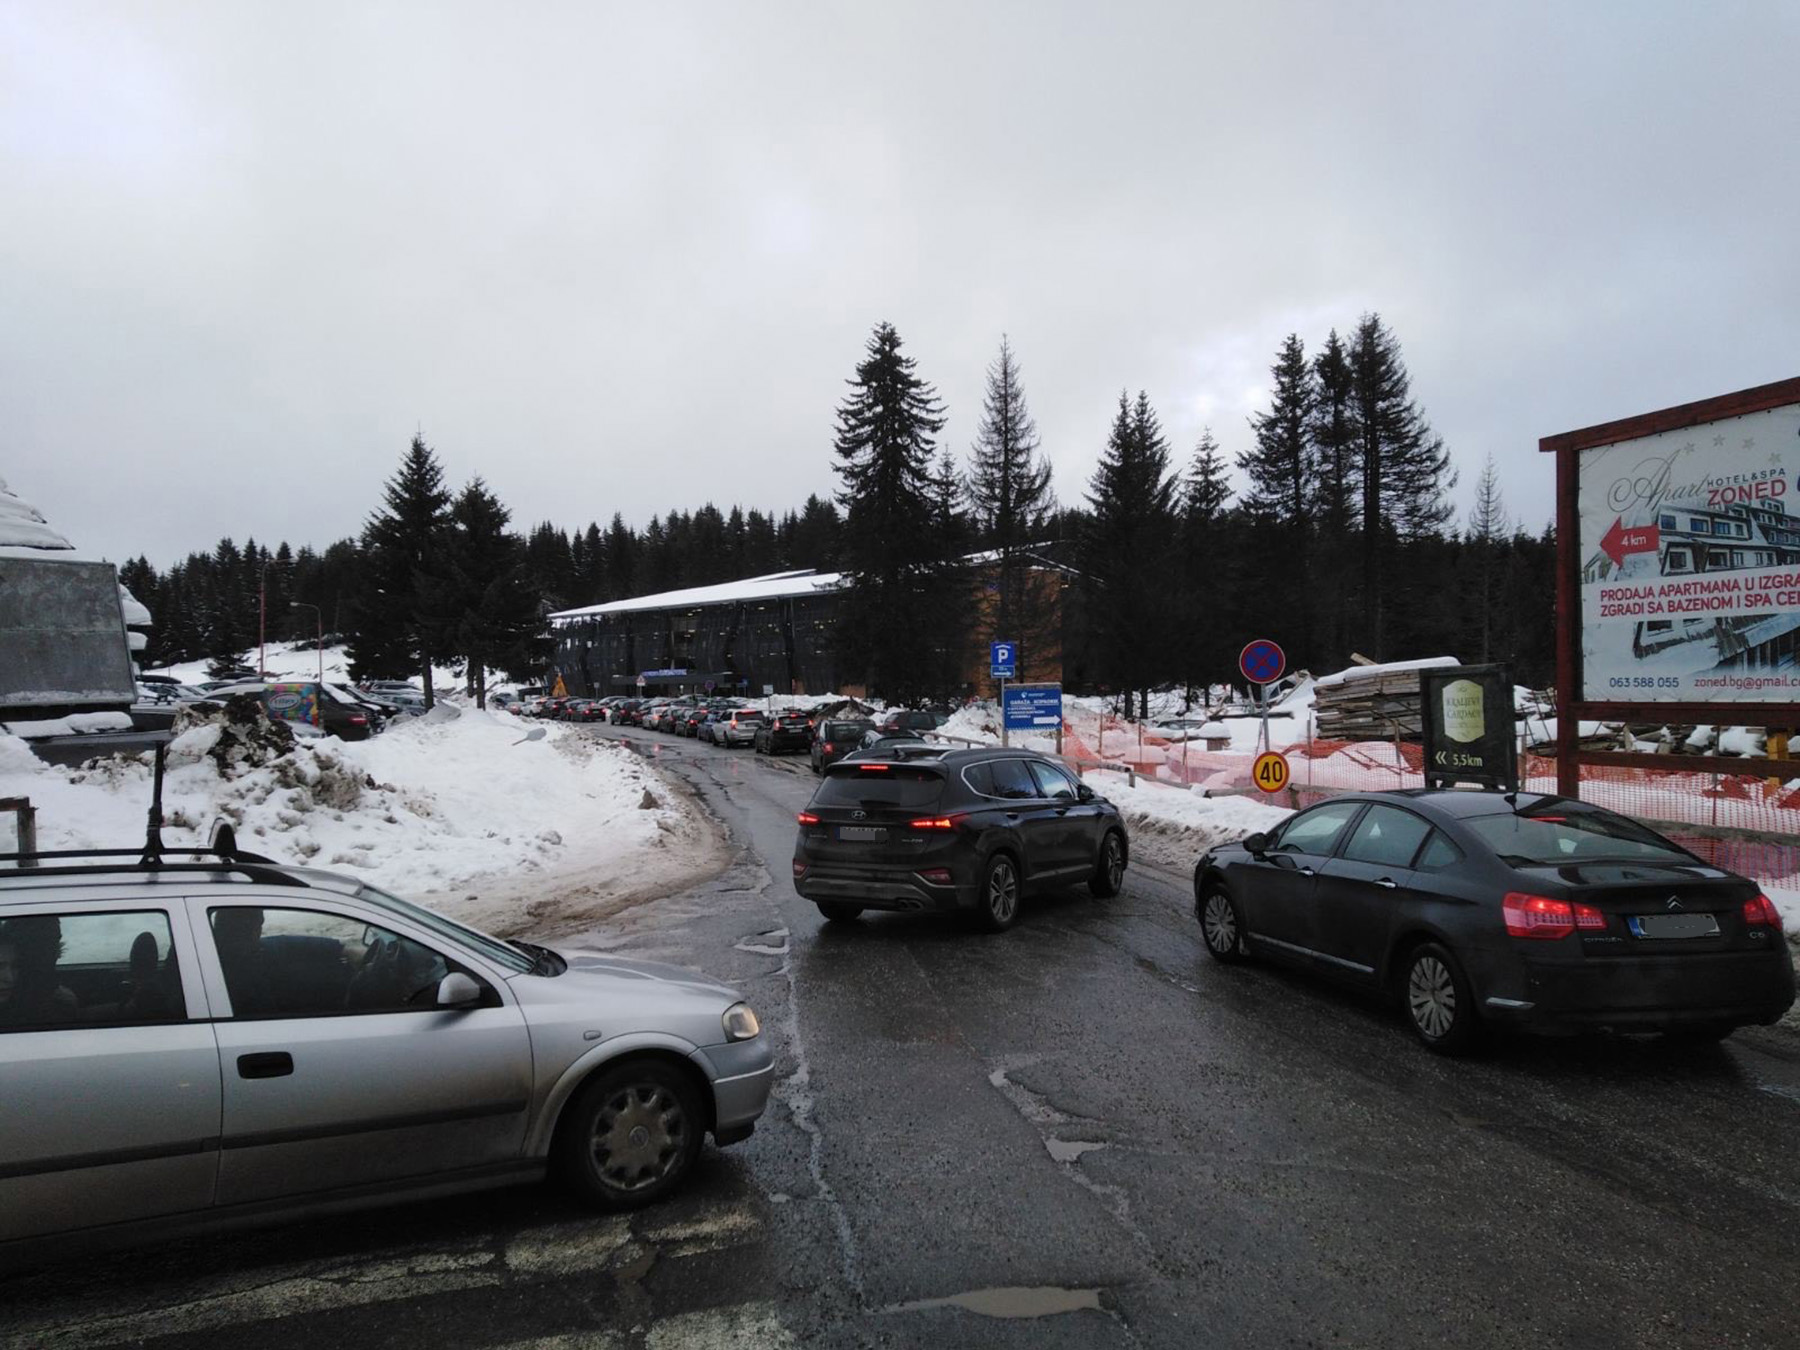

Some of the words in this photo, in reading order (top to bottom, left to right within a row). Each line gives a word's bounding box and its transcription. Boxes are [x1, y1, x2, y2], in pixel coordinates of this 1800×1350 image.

[1607, 449, 1710, 512] Apart
[1707, 479, 1786, 506] ZONED
[1621, 536, 1629, 546] 4
[1630, 534, 1647, 545] km
[1600, 586, 1655, 602] PRODAJA
[1658, 579, 1741, 597] APARTMANA
[1744, 577, 1755, 591] U
[1600, 602, 1644, 617] ZGRADI
[1647, 601, 1664, 614] SA
[1667, 596, 1733, 613] BAZENOM
[1744, 594, 1773, 608] SPA
[1776, 591, 1800, 606] CE
[998, 649, 1009, 663] P
[1609, 677, 1630, 688] 063
[1633, 677, 1654, 688] 588
[1657, 677, 1679, 688] 055
[1260, 761, 1283, 783] 40
